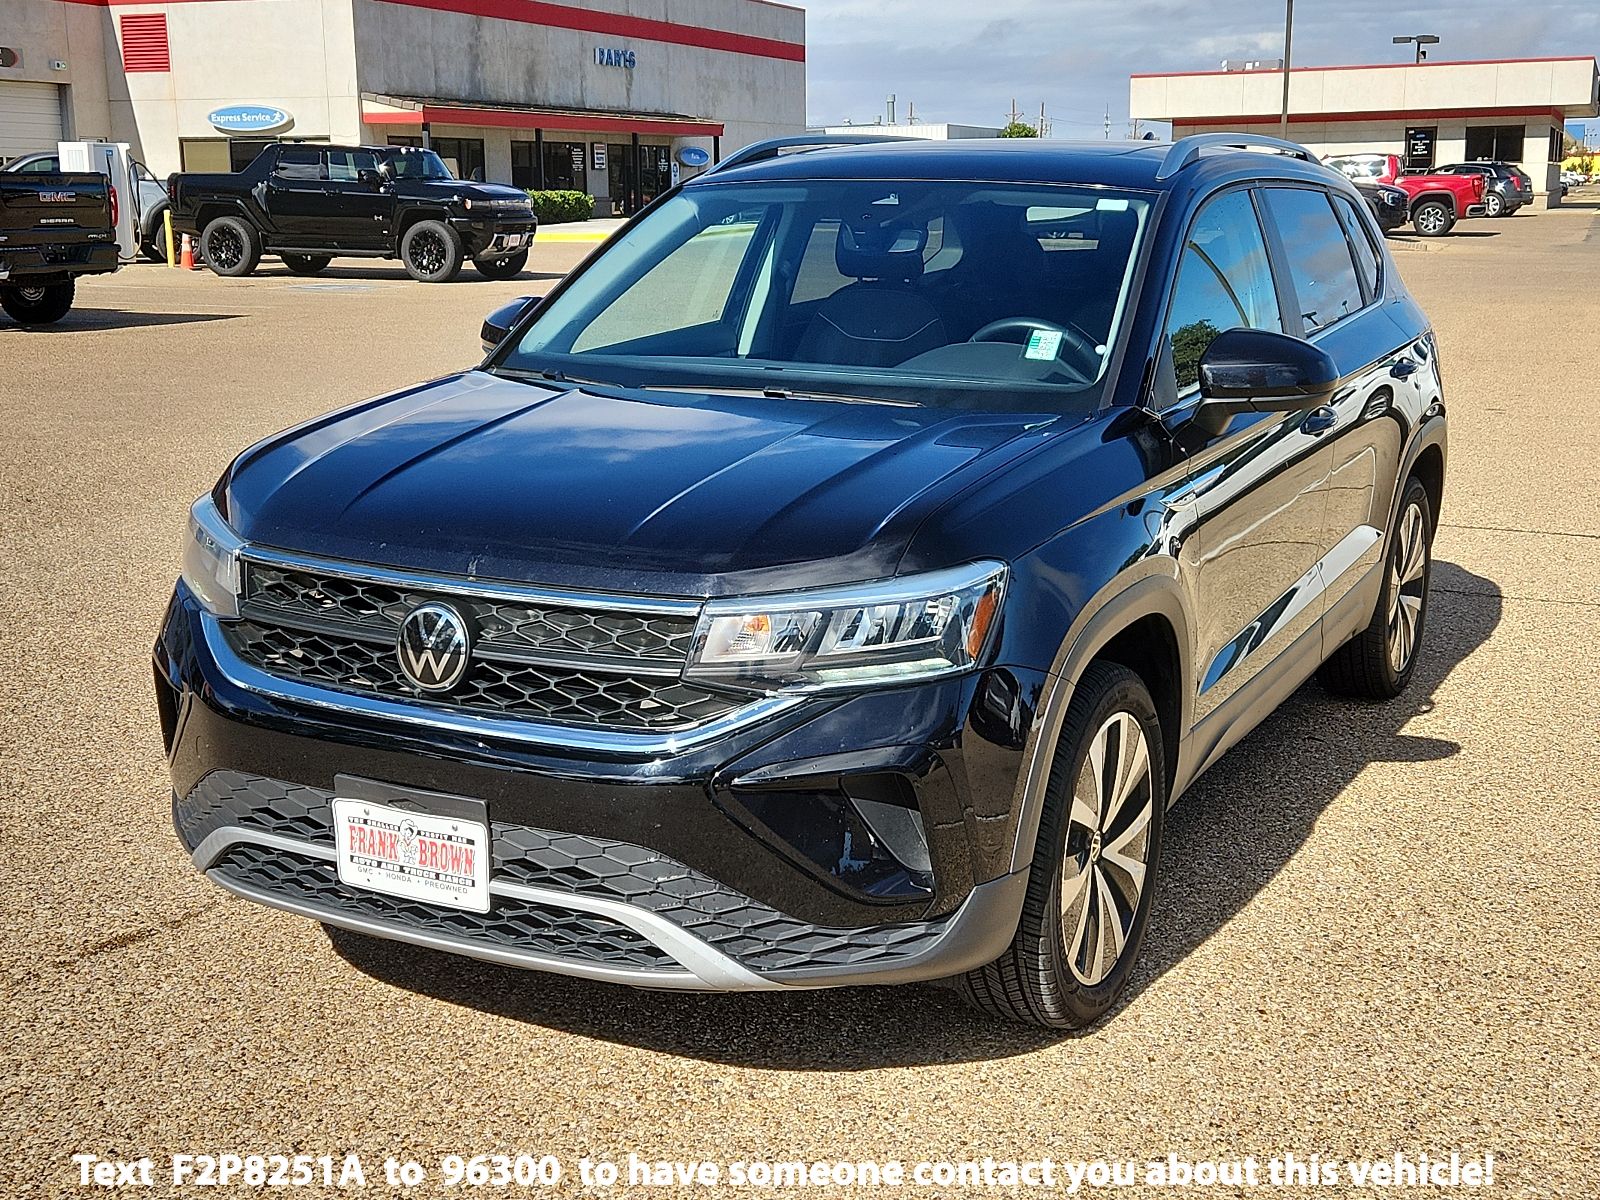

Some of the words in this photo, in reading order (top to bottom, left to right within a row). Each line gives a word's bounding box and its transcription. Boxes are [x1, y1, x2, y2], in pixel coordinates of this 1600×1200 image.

[597, 47, 636, 69] PARTS
[211, 113, 240, 124] Express
[241, 112, 271, 122] Service
[39, 192, 76, 202] GMC
[349, 825, 399, 862] FRANK
[418, 838, 475, 877] BROWN
[352, 856, 378, 868] AUTO
[380, 860, 399, 872] AND
[402, 865, 437, 880] TRUCK
[439, 874, 474, 887] RANCH
[357, 866, 374, 875] GMC
[385, 873, 412, 883] HONDA
[424, 880, 468, 894] PREOWNED
